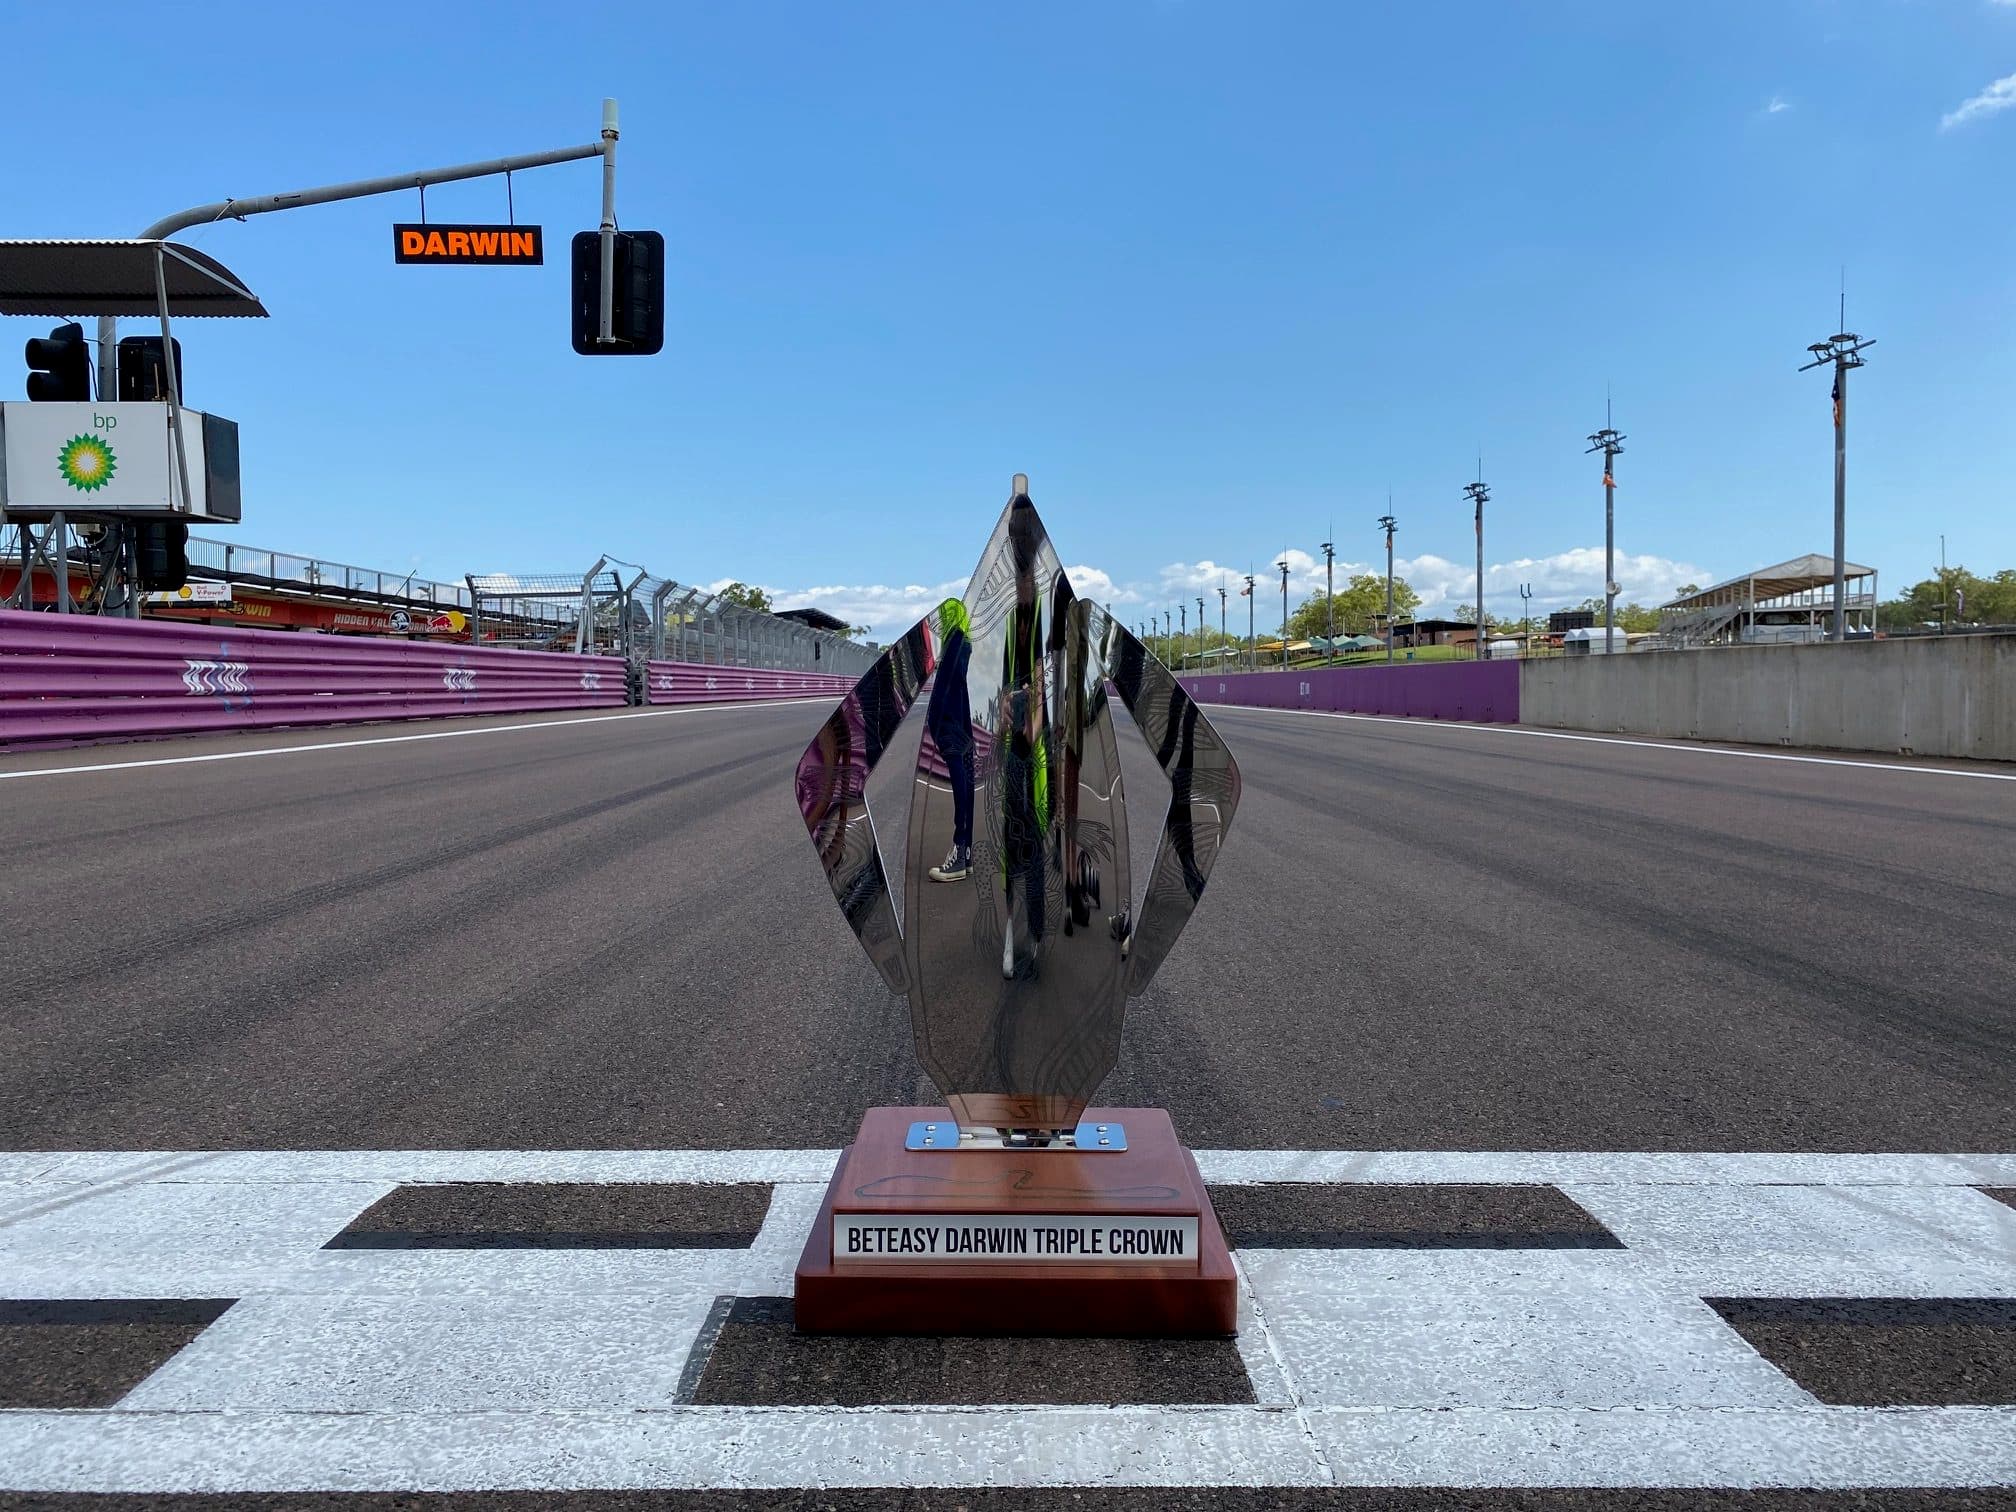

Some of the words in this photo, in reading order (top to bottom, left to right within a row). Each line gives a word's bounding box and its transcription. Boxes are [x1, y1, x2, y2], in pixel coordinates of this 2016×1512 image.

[402, 231, 534, 256] DARWIN
[93, 413, 117, 432] bp
[333, 613, 369, 626] HIDDEN
[848, 1227, 939, 1253] BETEASY
[945, 1227, 1027, 1254] DARWIN
[1033, 1228, 1103, 1254] TRIPLE
[1109, 1229, 1184, 1255] CROWN
